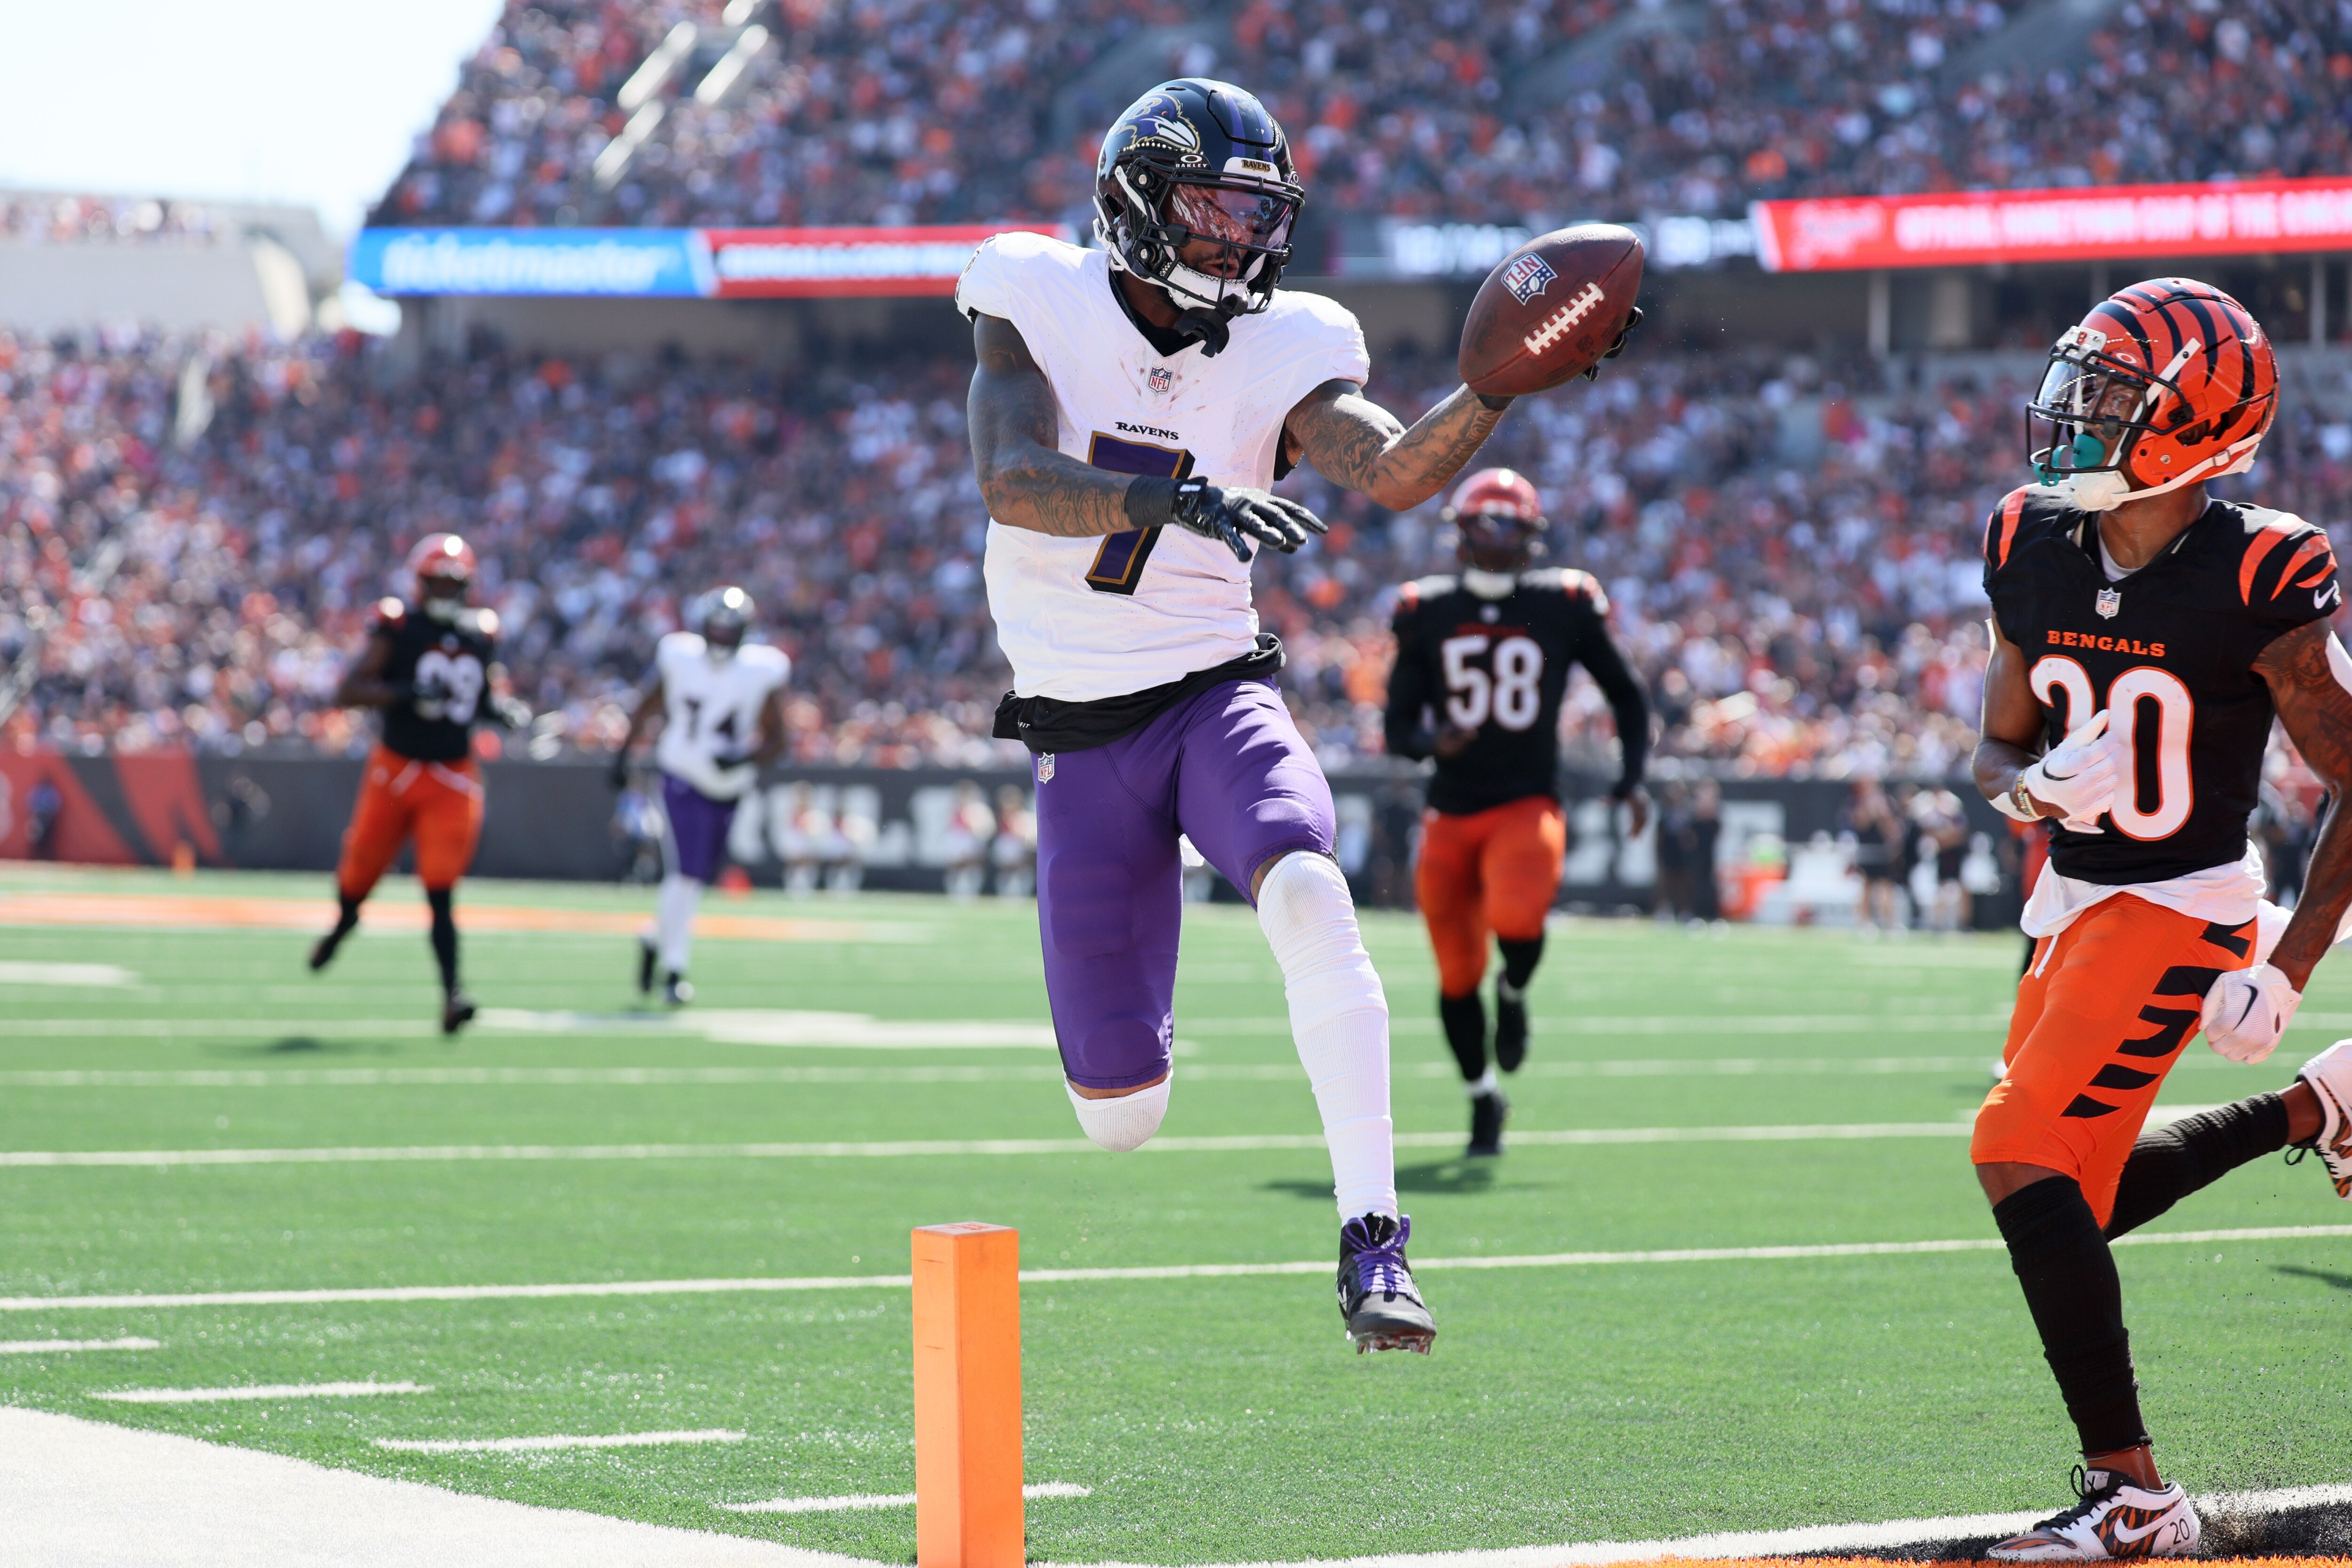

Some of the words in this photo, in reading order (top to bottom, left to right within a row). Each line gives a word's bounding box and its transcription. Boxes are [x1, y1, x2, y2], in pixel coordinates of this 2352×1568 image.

[1241, 159, 1271, 172] RAVENS
[1505, 256, 1541, 285] NFL
[1151, 376, 1167, 390] NFL
[1115, 422, 1179, 440] RAVENS
[2047, 630, 2165, 657] BENGALS
[1441, 635, 1544, 732] 58
[1041, 765, 1051, 778] NFL
[2169, 1518, 2190, 1545] 20
